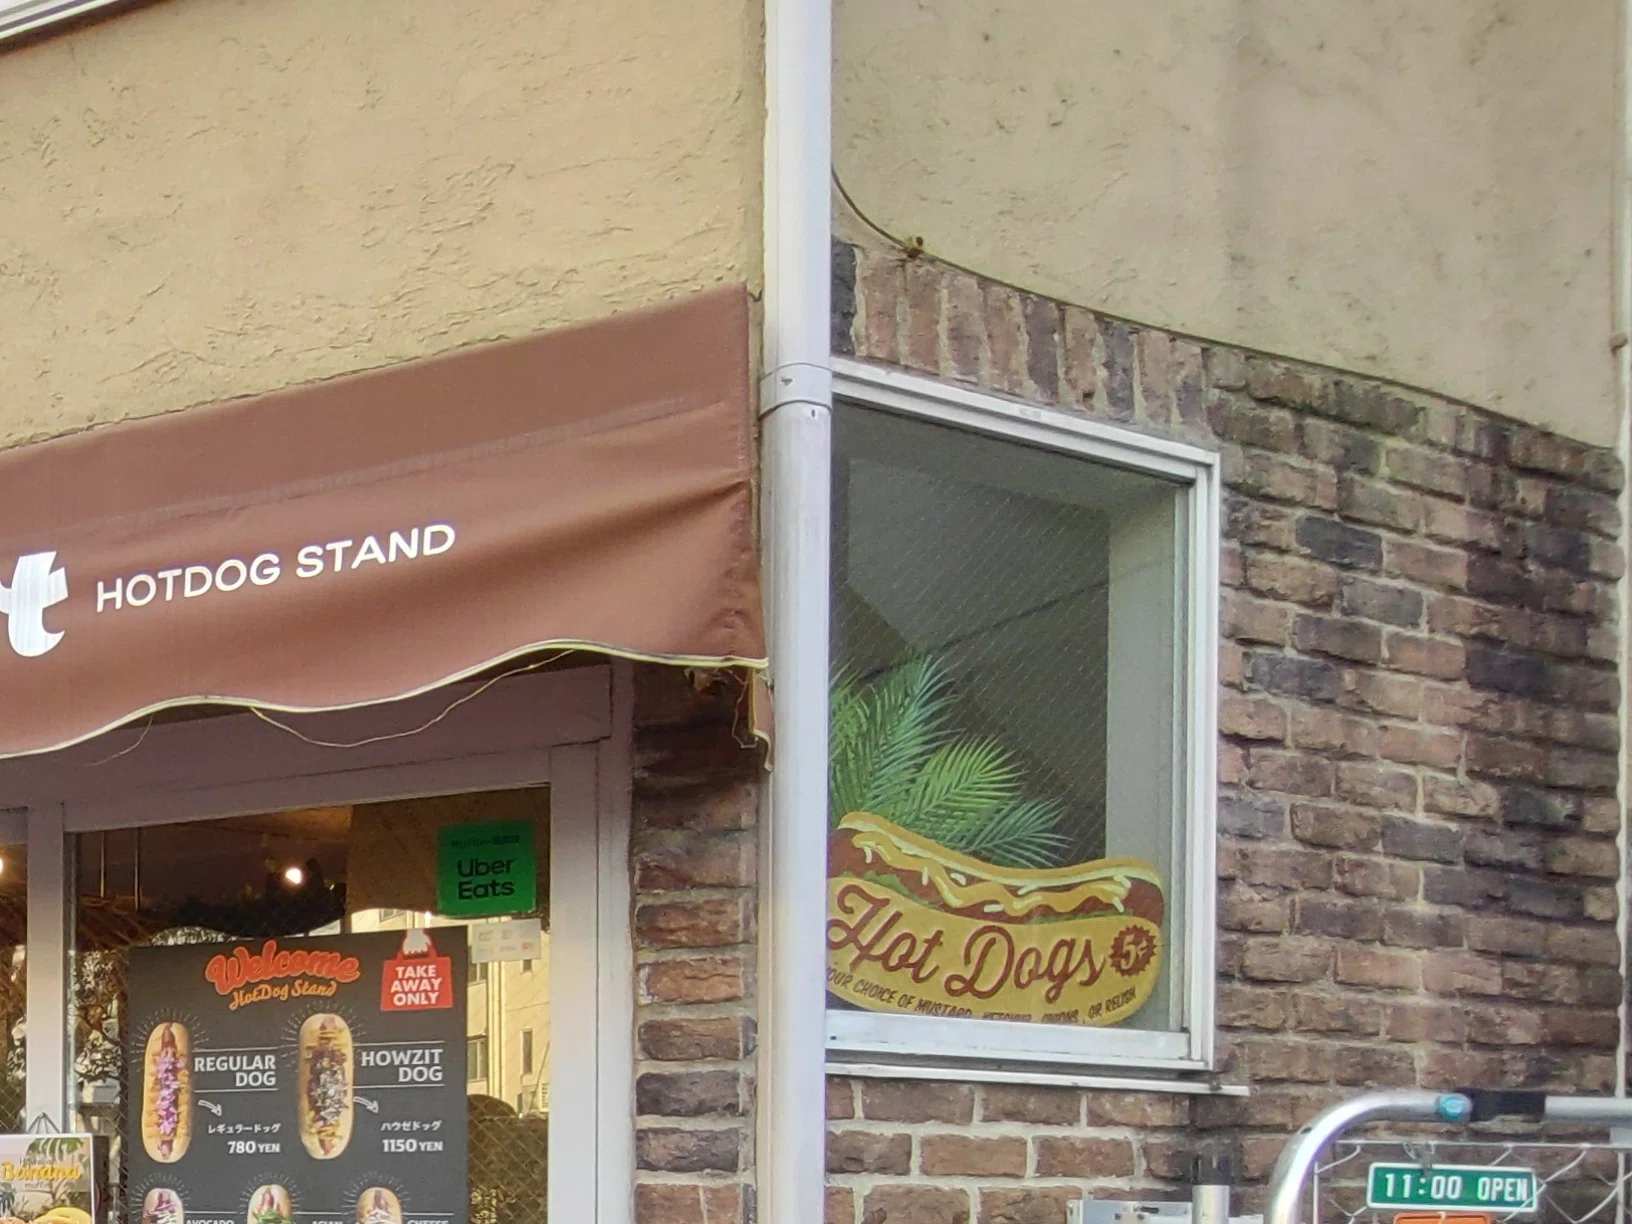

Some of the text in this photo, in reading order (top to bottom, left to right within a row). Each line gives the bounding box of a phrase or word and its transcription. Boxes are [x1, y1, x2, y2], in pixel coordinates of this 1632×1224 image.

[96, 552, 281, 613] HOTDOG
[295, 523, 457, 579] STAND
[457, 858, 515, 878] Uber
[458, 879, 516, 900] Eats
[826, 883, 1108, 1004] Hot Dogs
[205, 939, 361, 996] Welcome
[395, 964, 437, 979] TAKE
[291, 978, 338, 998] Stand
[390, 978, 442, 994] AWAY
[853, 978, 898, 1004] CHOICE
[897, 993, 916, 1008] OF
[393, 991, 440, 1007] ONLY
[194, 1054, 277, 1073] REGULAR
[360, 1049, 444, 1067] HOWZIT
[234, 1071, 277, 1088] DOG
[397, 1065, 444, 1084] DOG
[207, 1122, 282, 1135] レギュラードッグ
[227, 1140, 281, 1155] 780 YEN
[382, 1138, 444, 1153] 1150 YEN
[1, 1160, 82, 1182] Banana
[1384, 1173, 1529, 1201] 11:00 OPEN
